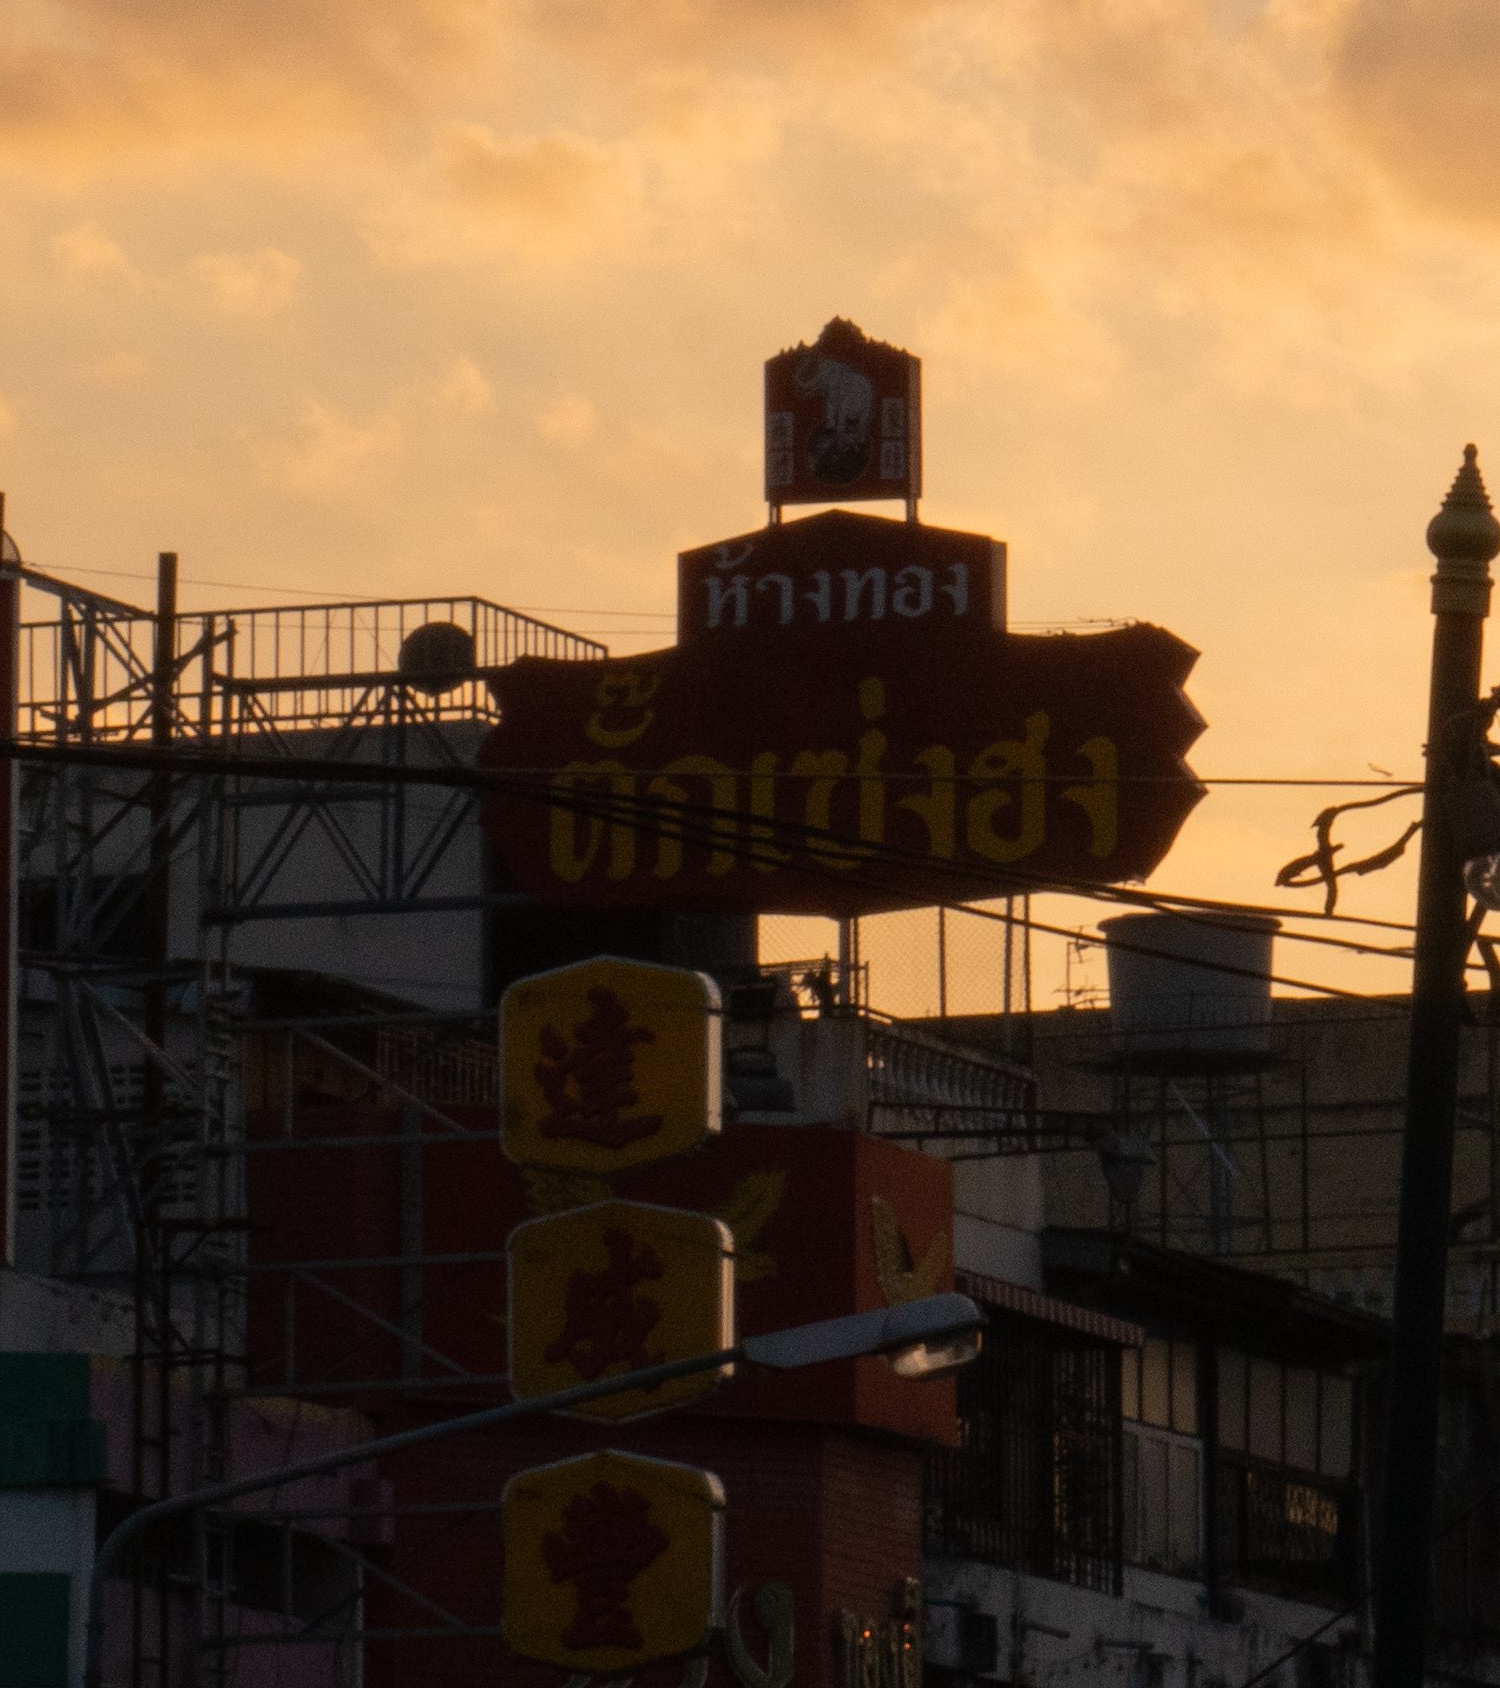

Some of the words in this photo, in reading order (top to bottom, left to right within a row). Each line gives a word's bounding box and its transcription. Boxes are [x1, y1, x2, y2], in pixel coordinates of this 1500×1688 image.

[704, 544, 969, 629] ห้างทอง
[550, 672, 1120, 880] ตั๊กเซ่งฮง
